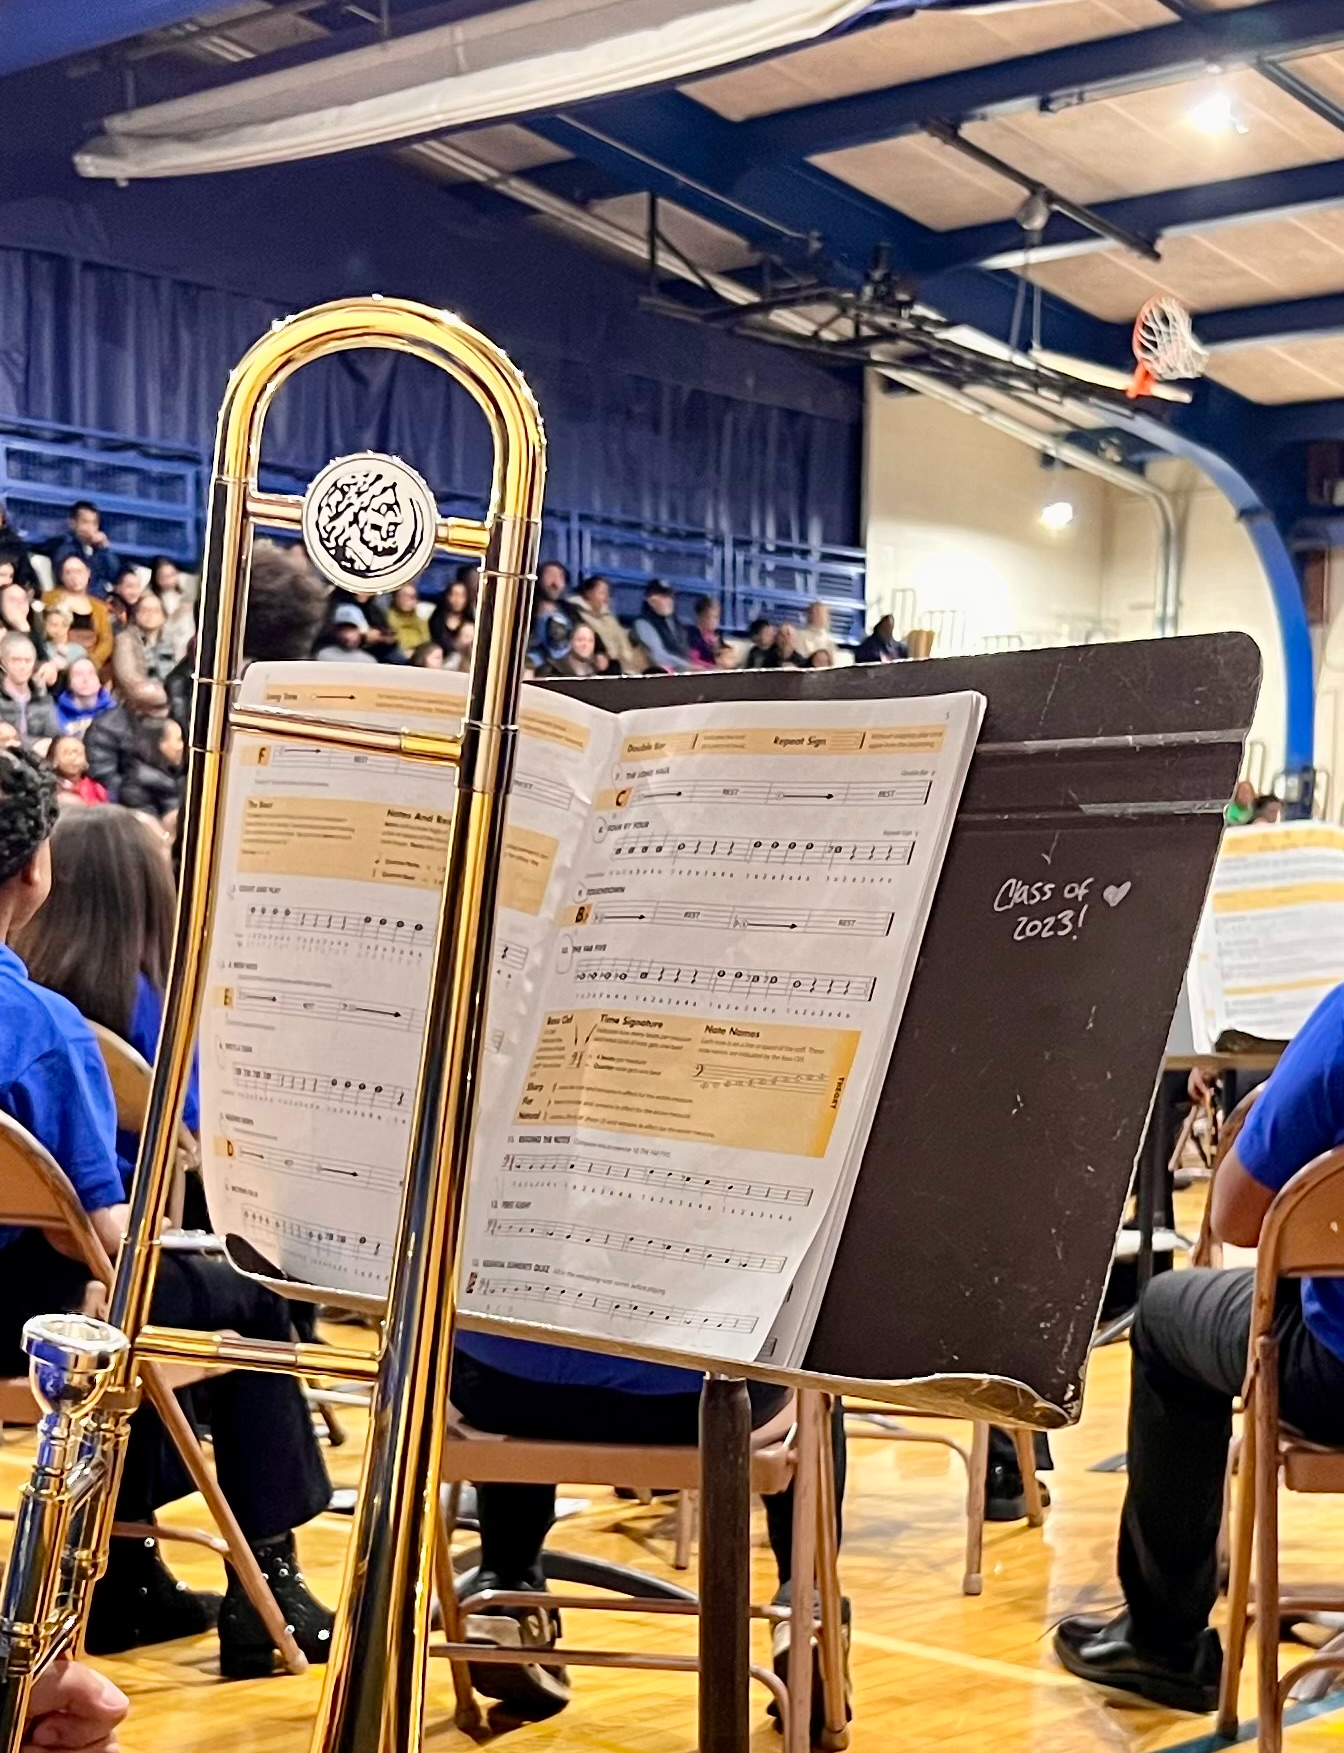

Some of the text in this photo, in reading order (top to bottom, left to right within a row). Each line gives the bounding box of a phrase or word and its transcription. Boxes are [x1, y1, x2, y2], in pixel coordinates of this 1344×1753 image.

[773, 735, 827, 746] Repeat Sign
[257, 747, 266, 764] F
[616, 790, 627, 807] C
[877, 789, 896, 798] REST
[414, 813, 434, 822] And
[993, 877, 1095, 912] Class of
[1013, 903, 1089, 941] 2023!
[600, 1013, 664, 1029] Time Signature
[704, 1025, 760, 1038] Note Names
[829, 1077, 845, 1109] THEORY
[226, 1139, 234, 1156] D
